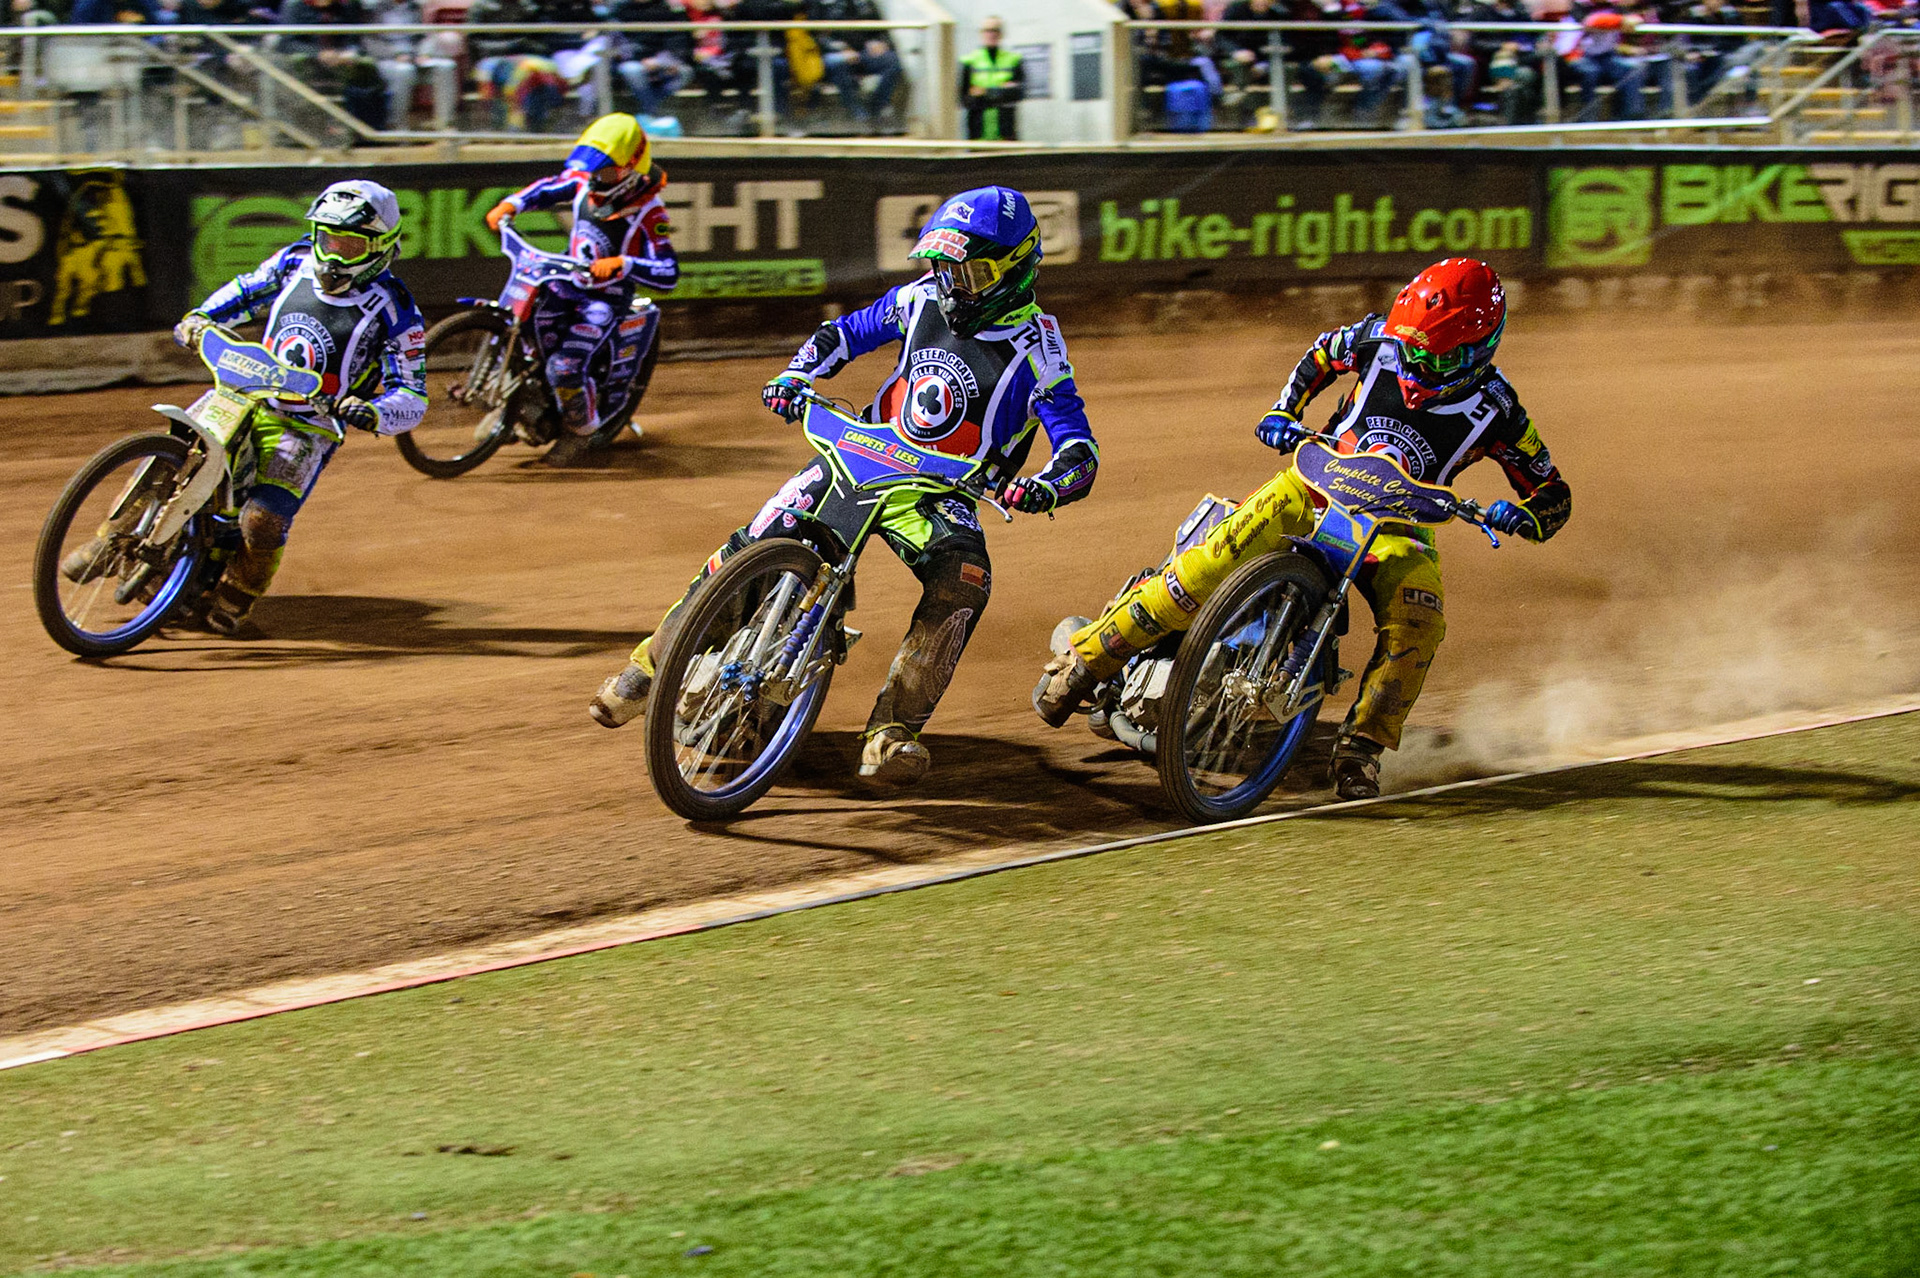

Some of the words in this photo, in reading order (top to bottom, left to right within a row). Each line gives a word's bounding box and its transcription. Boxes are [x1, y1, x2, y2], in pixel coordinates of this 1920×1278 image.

[1100, 194, 1532, 270] bike-right.com
[912, 348, 946, 365] PETER
[946, 353, 980, 398] CRAVEN
[938, 368, 954, 384] VUE
[951, 385, 963, 408] ACES
[844, 430, 886, 452] CARPETS
[884, 443, 898, 457] 4
[894, 450, 920, 466] LESS
[1366, 416, 1401, 432] PETER
[1401, 425, 1437, 465] CRAVEN
[1367, 434, 1389, 445] BELLE
[1393, 437, 1411, 453] VUE
[1409, 455, 1420, 475] ACES
[1324, 459, 1381, 487] Complete
[1165, 571, 1199, 613] JCB
[1404, 589, 1443, 613] JCB
